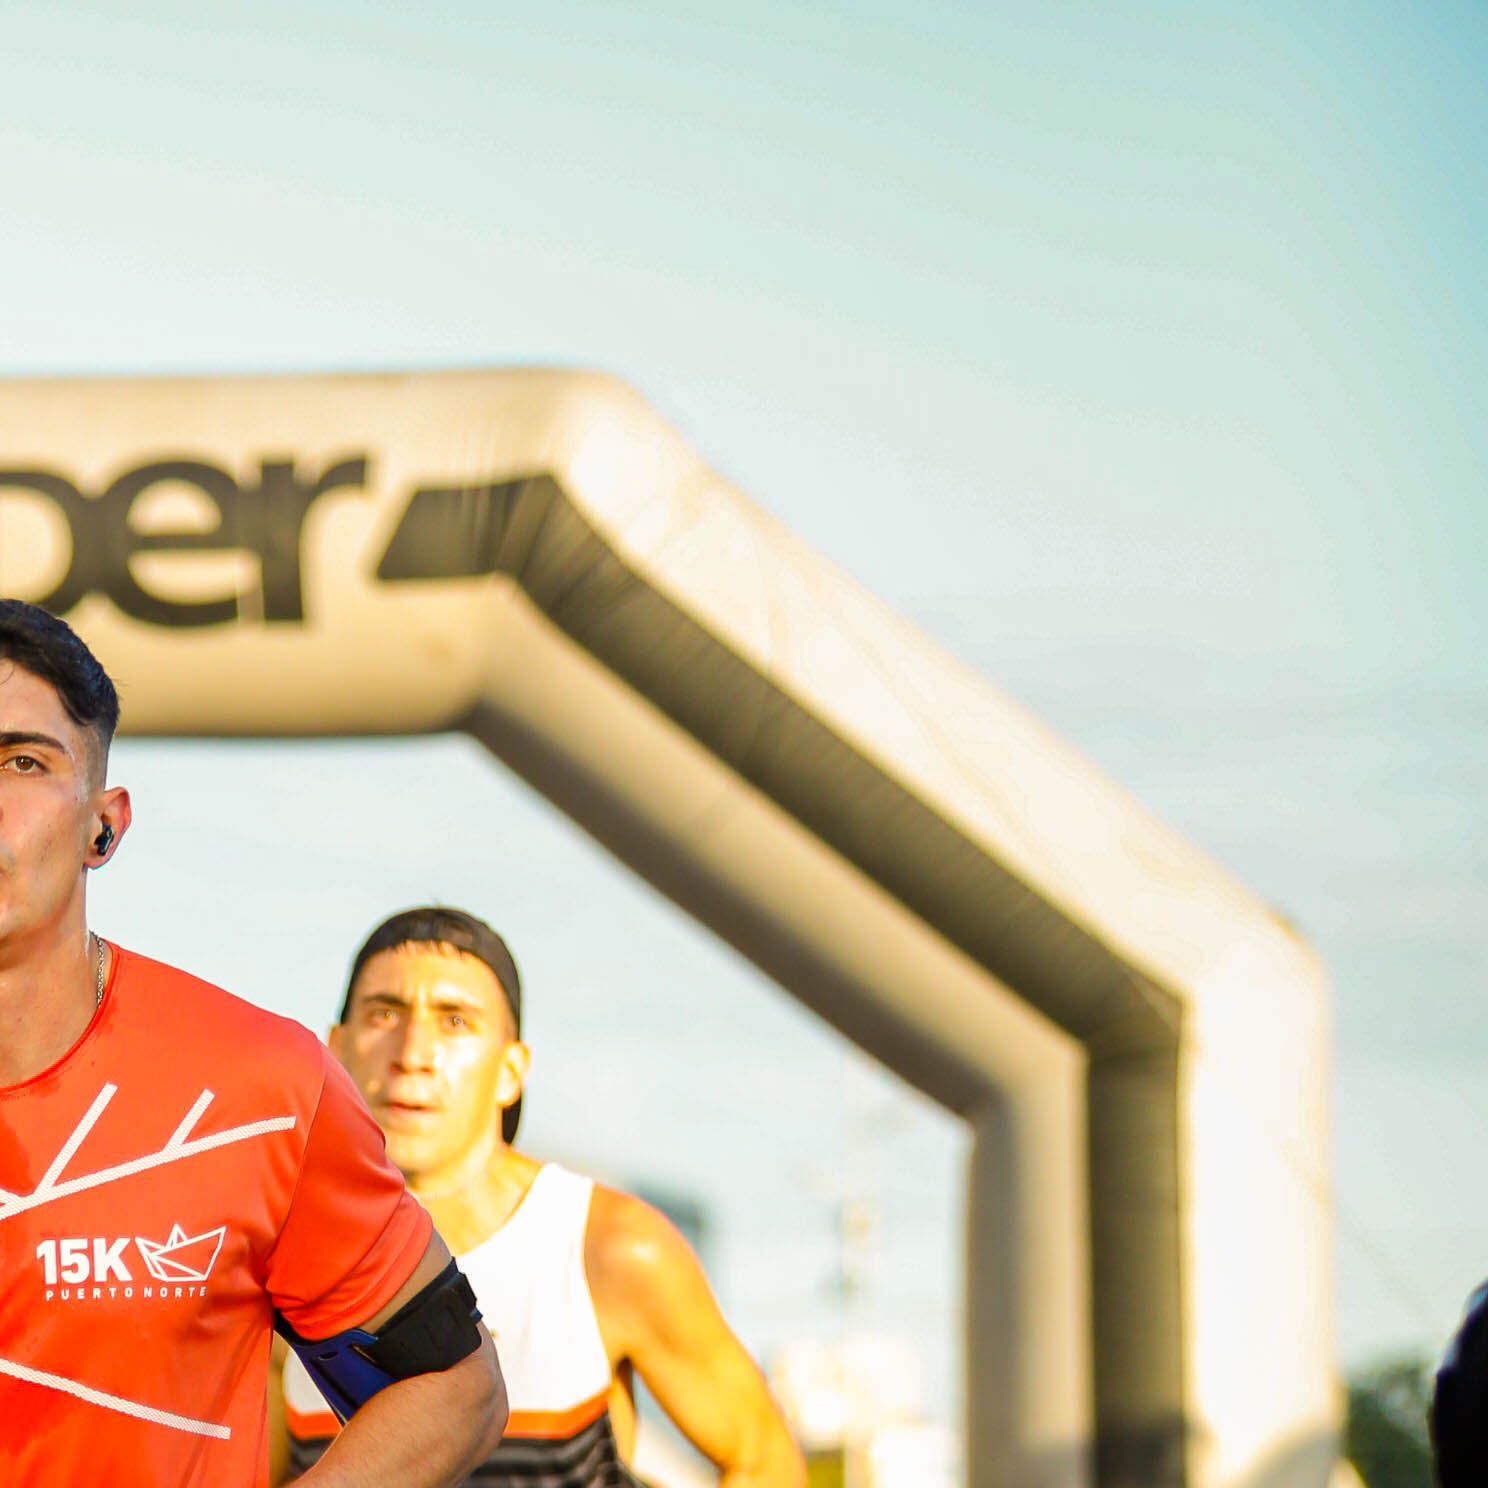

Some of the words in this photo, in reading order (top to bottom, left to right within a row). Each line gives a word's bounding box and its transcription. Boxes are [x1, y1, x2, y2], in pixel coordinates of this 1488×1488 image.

[36, 1237, 134, 1284] 15K
[45, 1287, 135, 1300] PUERTO
[143, 1286, 208, 1298] NORTE
